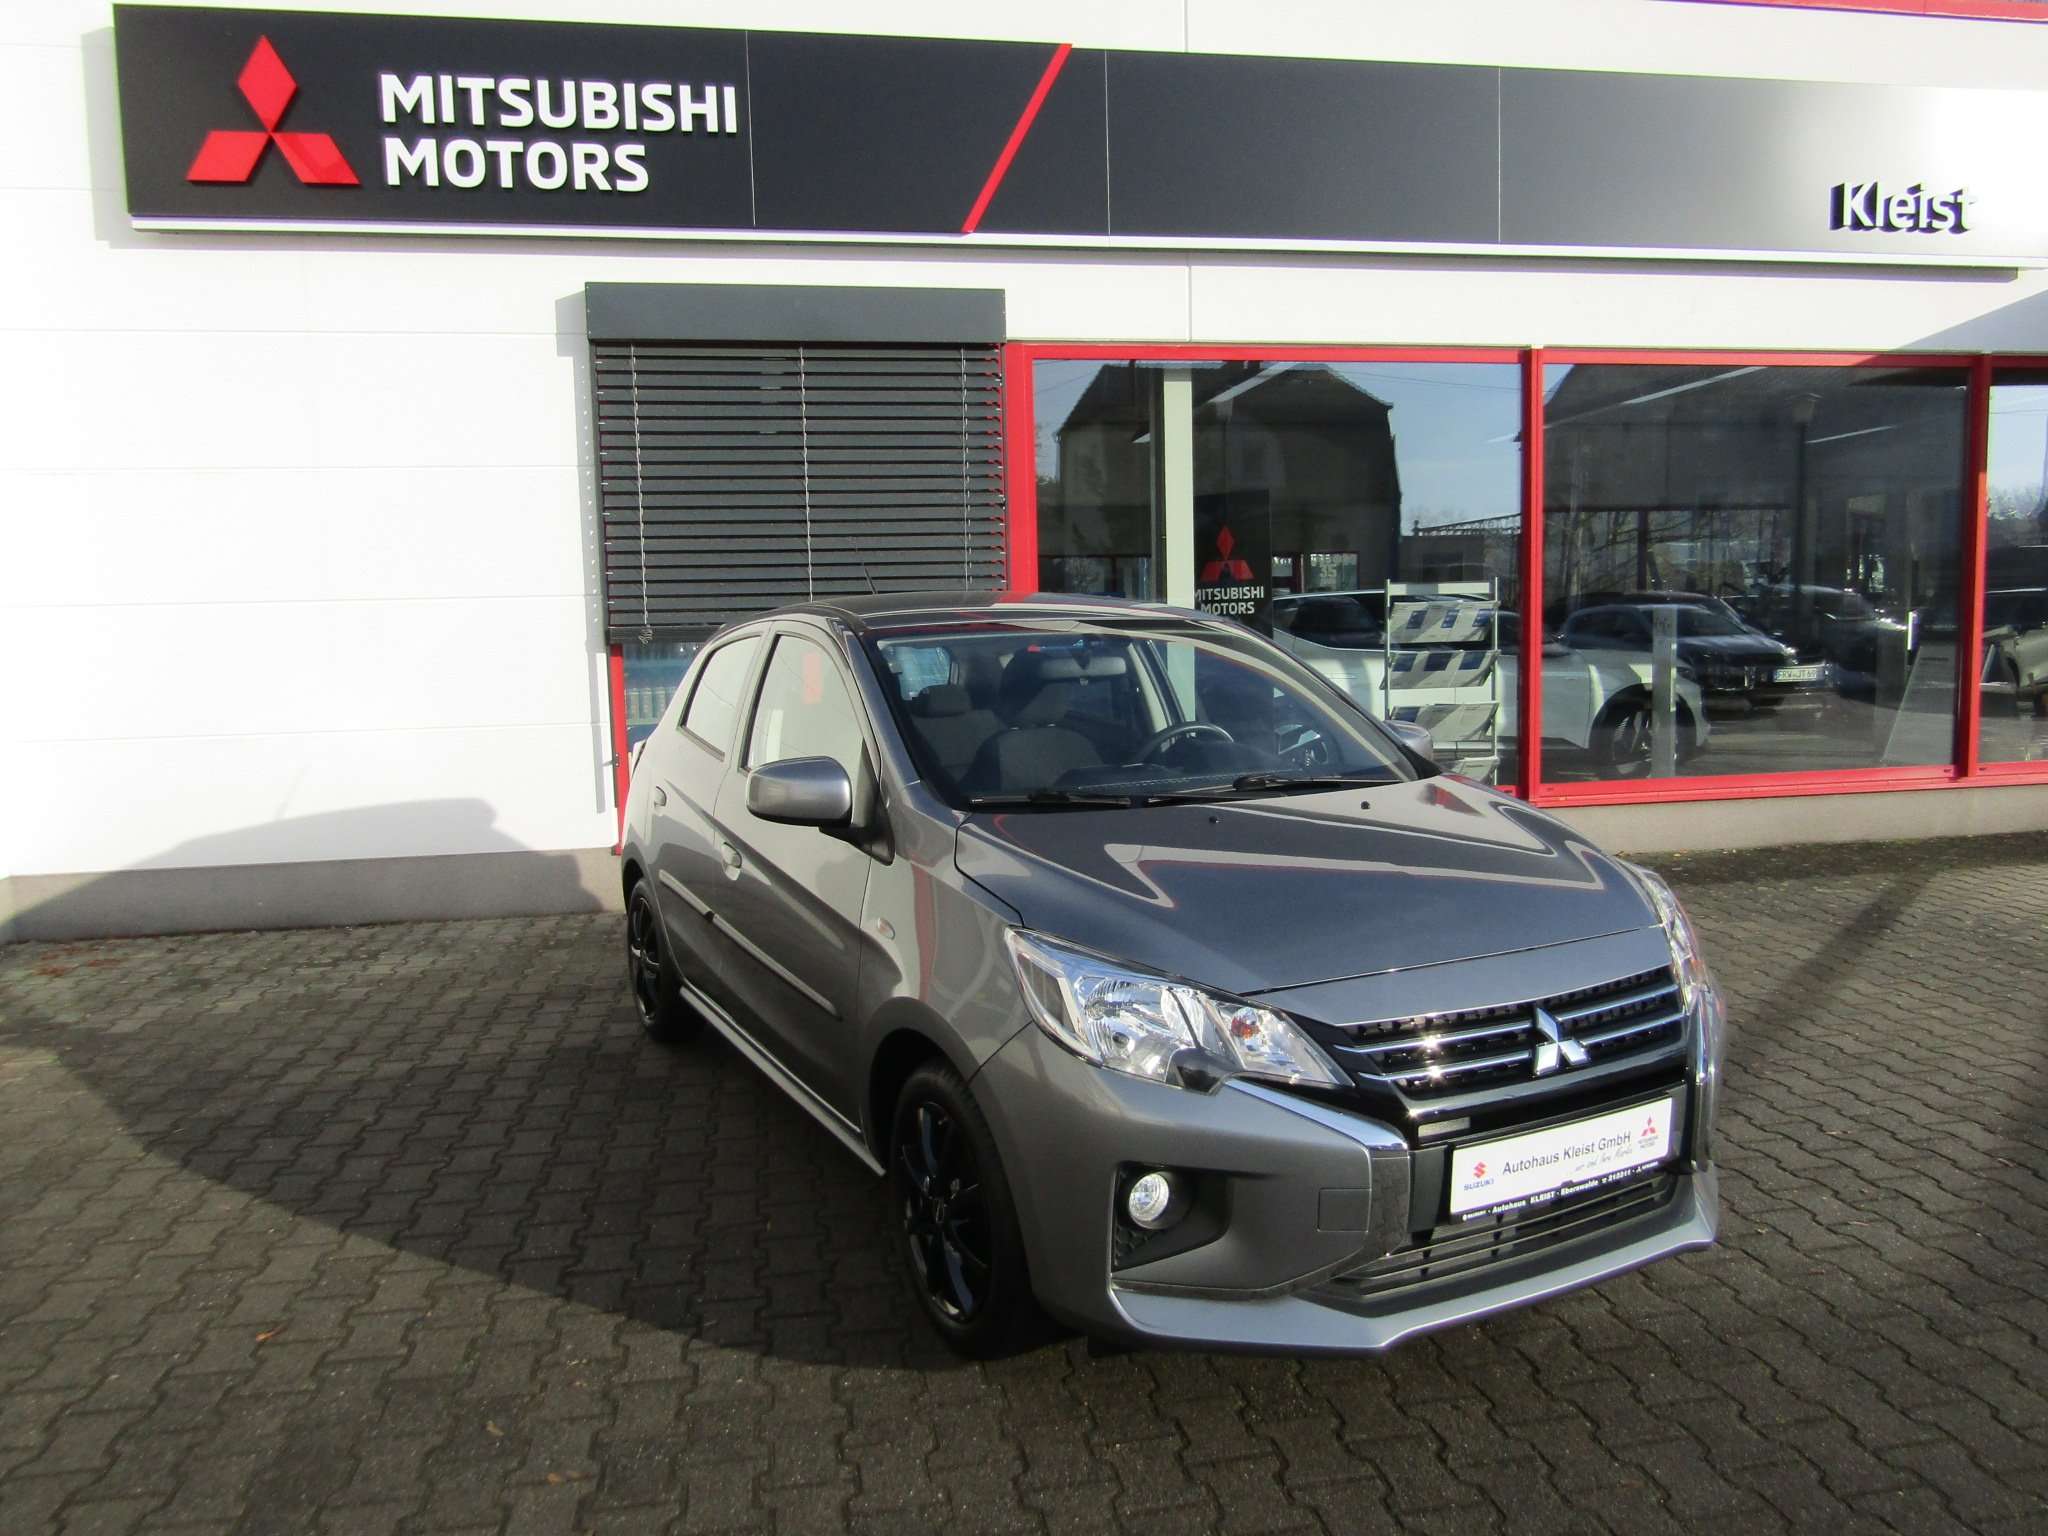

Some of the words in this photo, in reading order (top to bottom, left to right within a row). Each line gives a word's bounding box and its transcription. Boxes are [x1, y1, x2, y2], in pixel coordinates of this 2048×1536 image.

[379, 73, 738, 134] MITSUBISHI
[383, 136, 649, 192] MOTORS
[1829, 180, 1971, 234] Kleist
[1200, 602, 1255, 615] MOTORS
[1502, 1151, 1560, 1175] Autohaus
[1563, 1141, 1595, 1161] Kleist
[1598, 1129, 1631, 1151] GmbH
